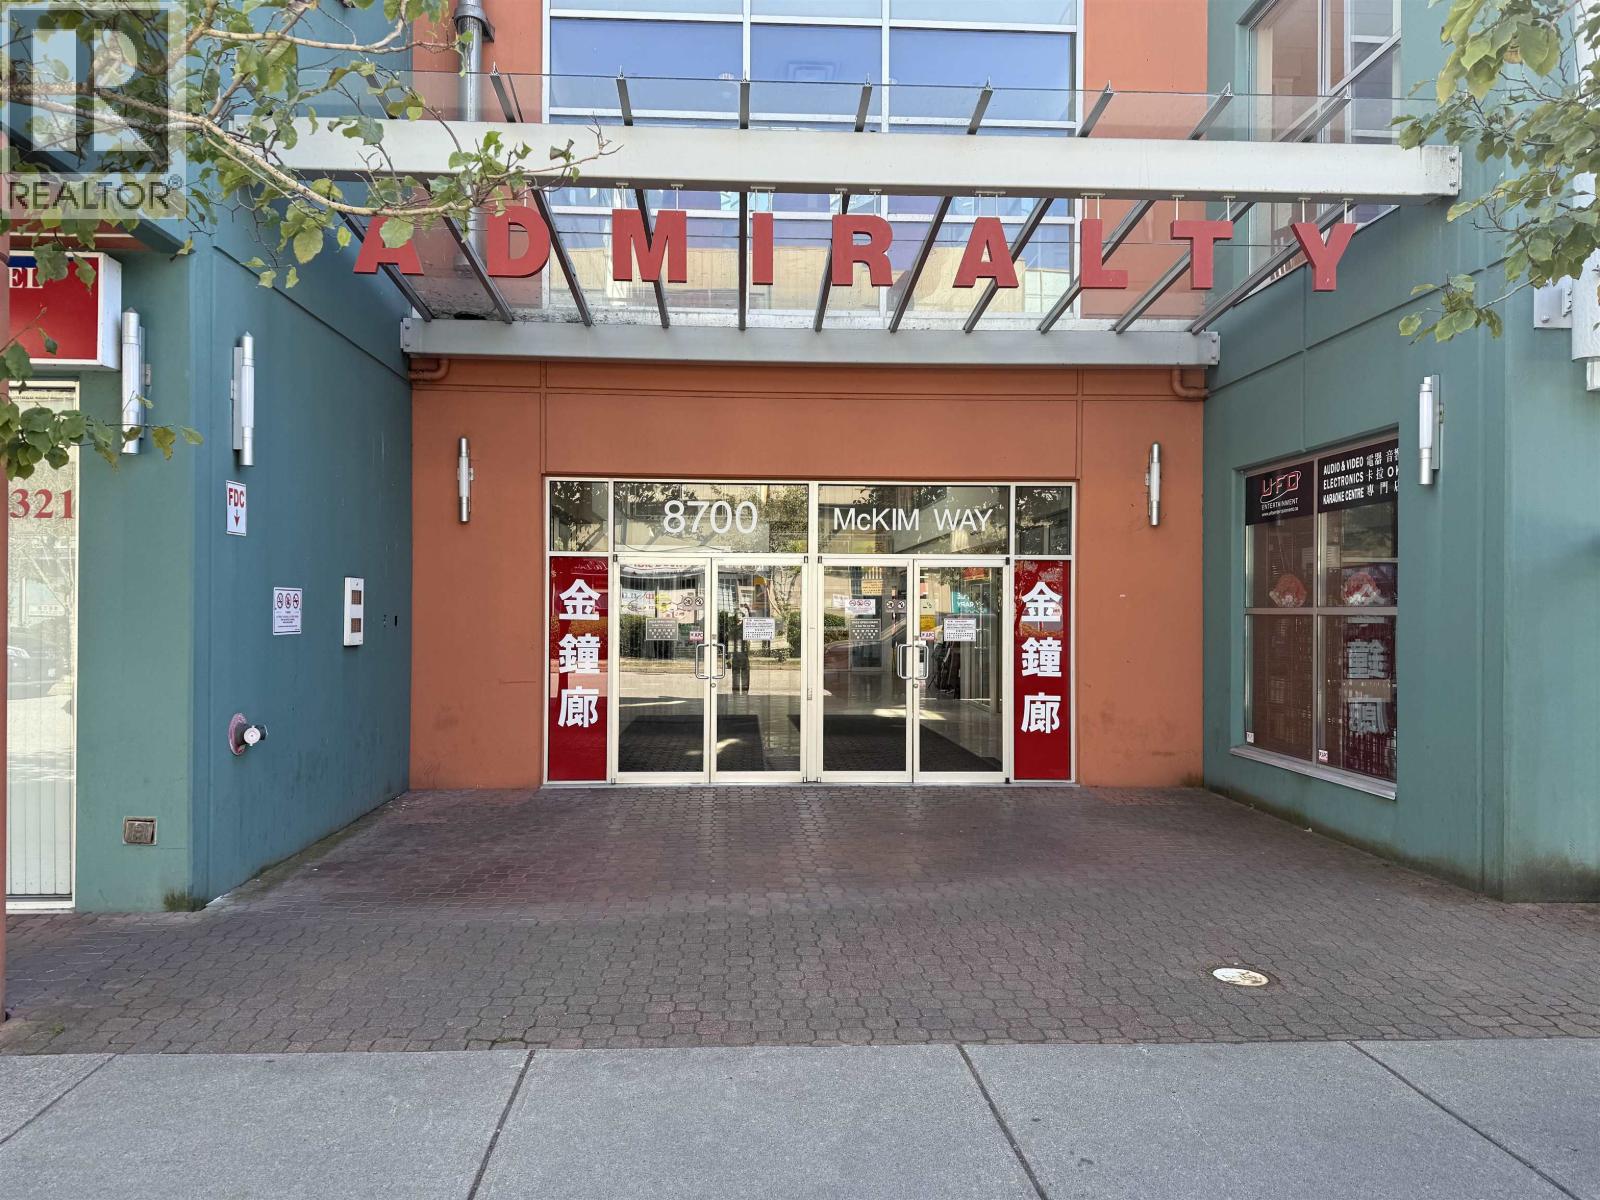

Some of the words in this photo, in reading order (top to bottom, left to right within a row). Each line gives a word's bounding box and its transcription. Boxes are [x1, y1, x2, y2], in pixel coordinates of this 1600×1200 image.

[353, 206, 1357, 292] ADMIRALTY
[1323, 461, 1340, 475] AUDIO
[1341, 461, 1345, 471] &
[1346, 456, 1364, 470] VIDEO
[1262, 471, 1300, 497] UFO
[1323, 472, 1364, 490] ELECTRONICS
[10, 488, 73, 519] 321
[228, 487, 245, 508] FDC
[1323, 491, 1344, 505] KARAOKE
[1345, 487, 1364, 501] CENTRE
[663, 500, 758, 534] 8700
[833, 507, 919, 531] McKIM
[934, 508, 993, 531] WAY
[558, 578, 601, 728] 金鐘廊
[1020, 581, 1062, 734] 金鐘廊
